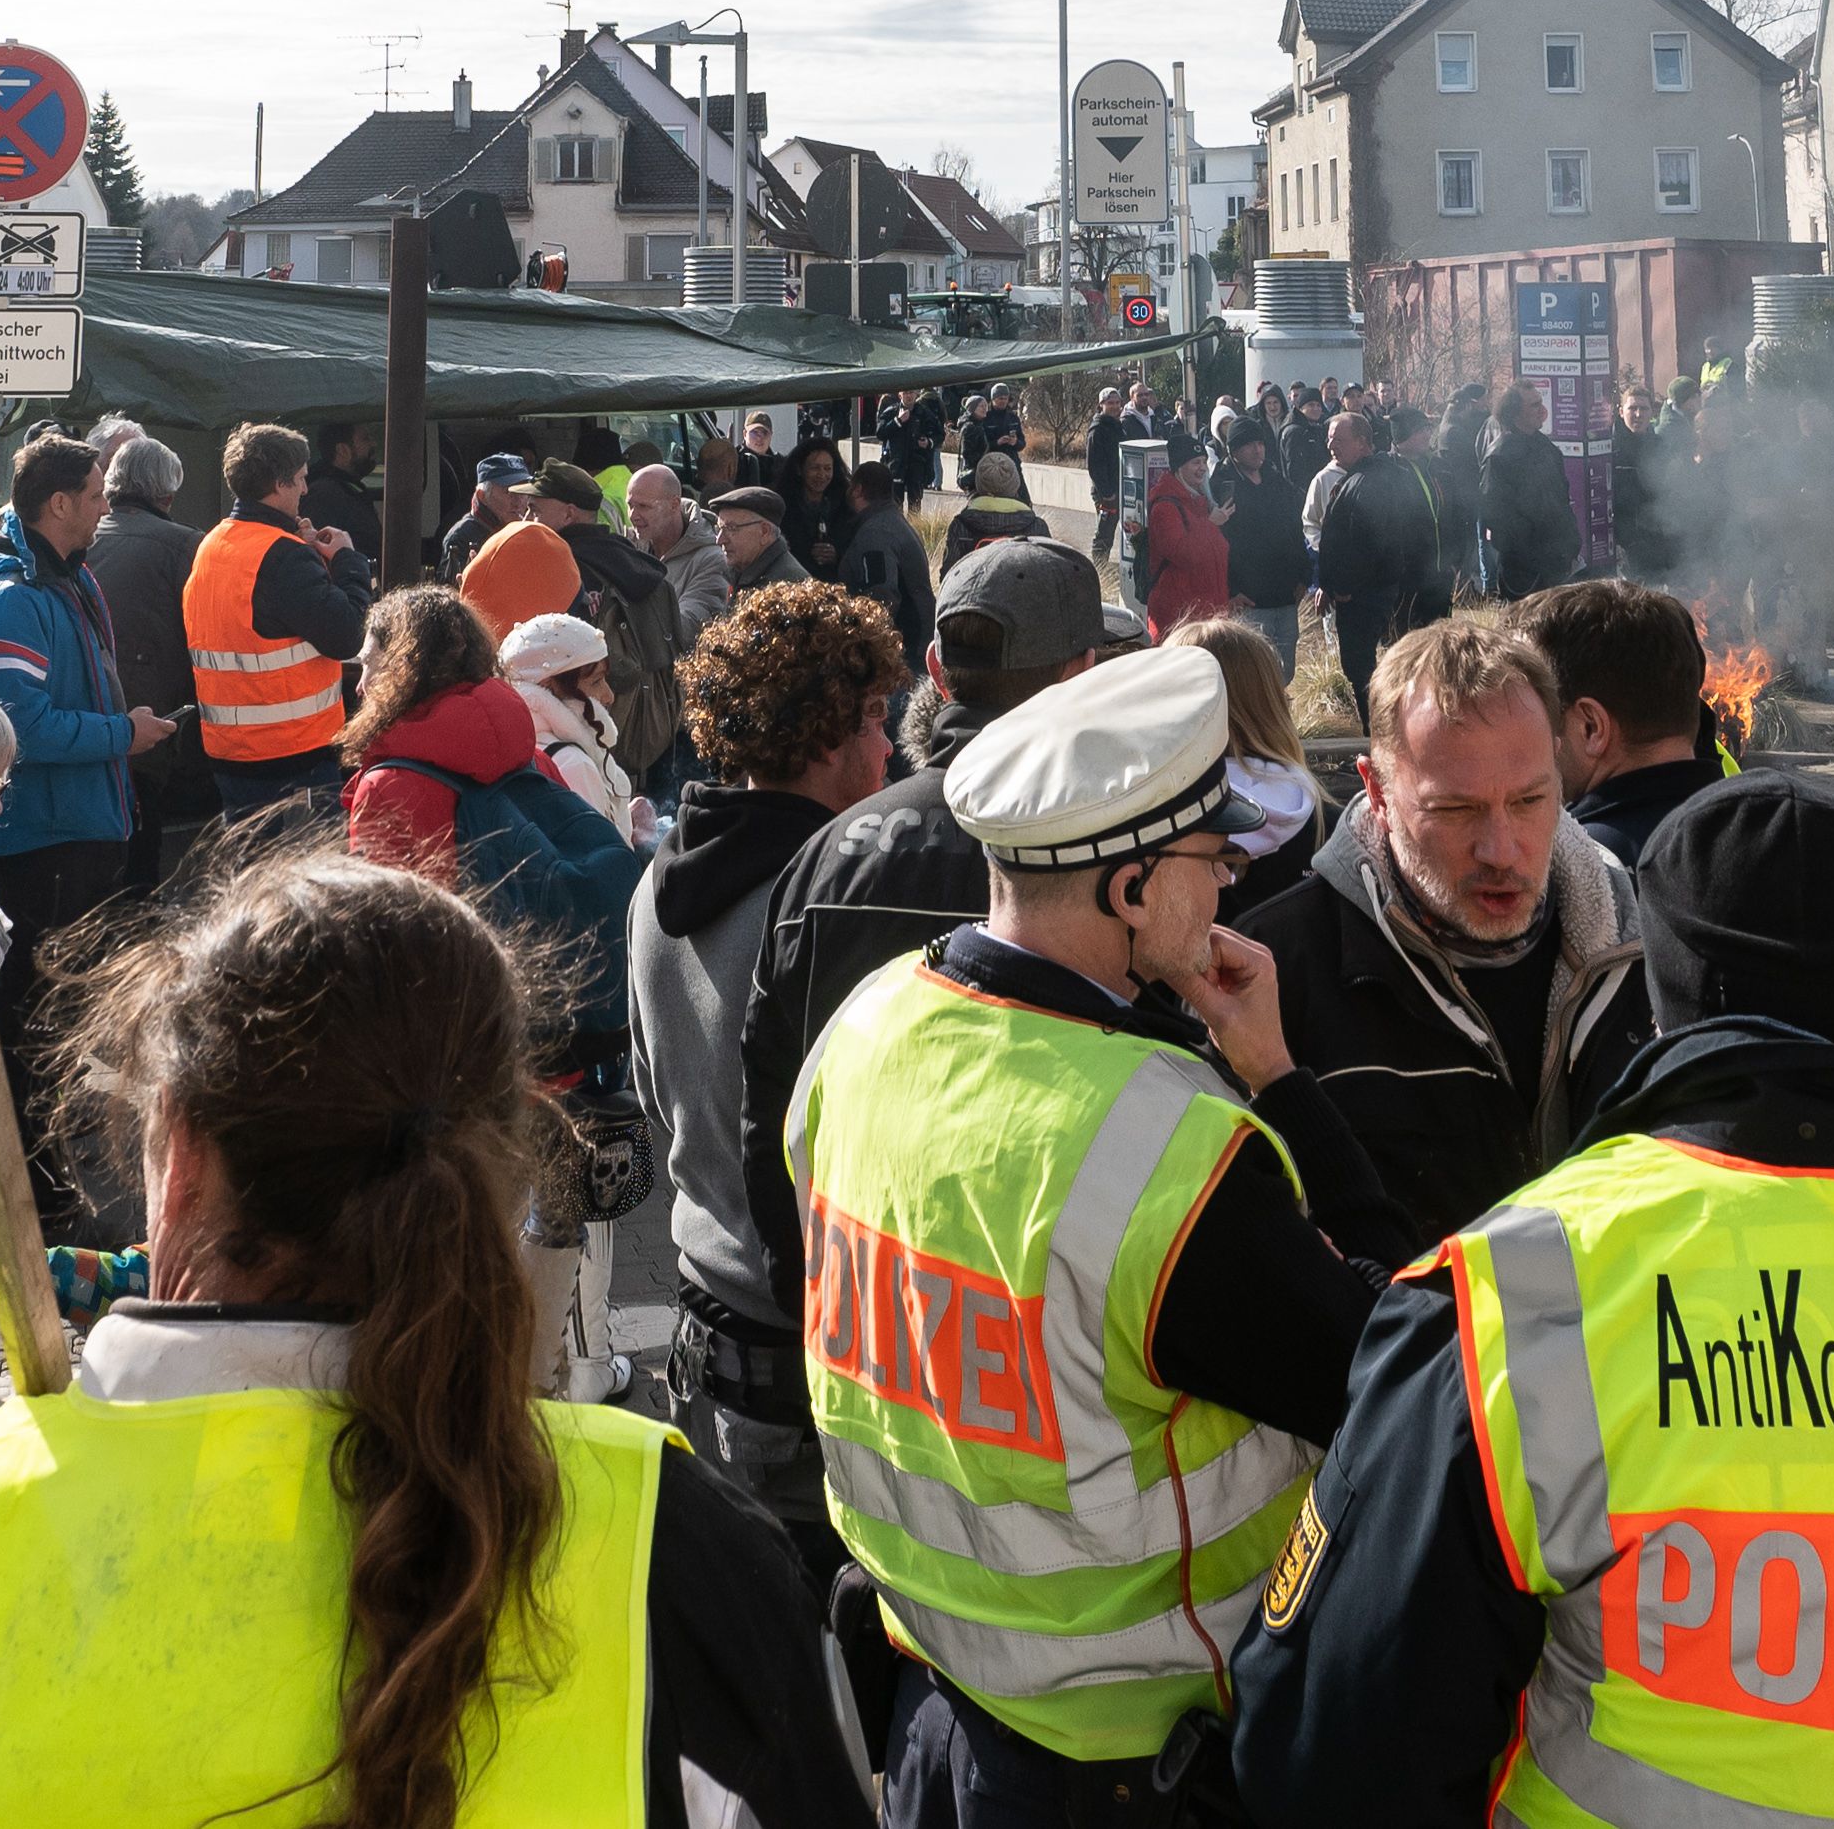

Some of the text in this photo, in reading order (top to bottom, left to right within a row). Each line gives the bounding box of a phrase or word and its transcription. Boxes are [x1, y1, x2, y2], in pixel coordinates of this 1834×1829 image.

[1079, 97, 1161, 111] Parkschein-
[1091, 113, 1149, 127] automat
[1108, 172, 1135, 184] Hier
[1087, 186, 1156, 199] Parkschein
[1104, 202, 1139, 213] lösen
[17, 273, 35, 291] 4:00
[36, 273, 52, 291] Uhr
[1540, 291, 1558, 318] P
[1591, 291, 1600, 317] P
[1132, 305, 1148, 319] 30
[1542, 320, 1574, 330] 884007
